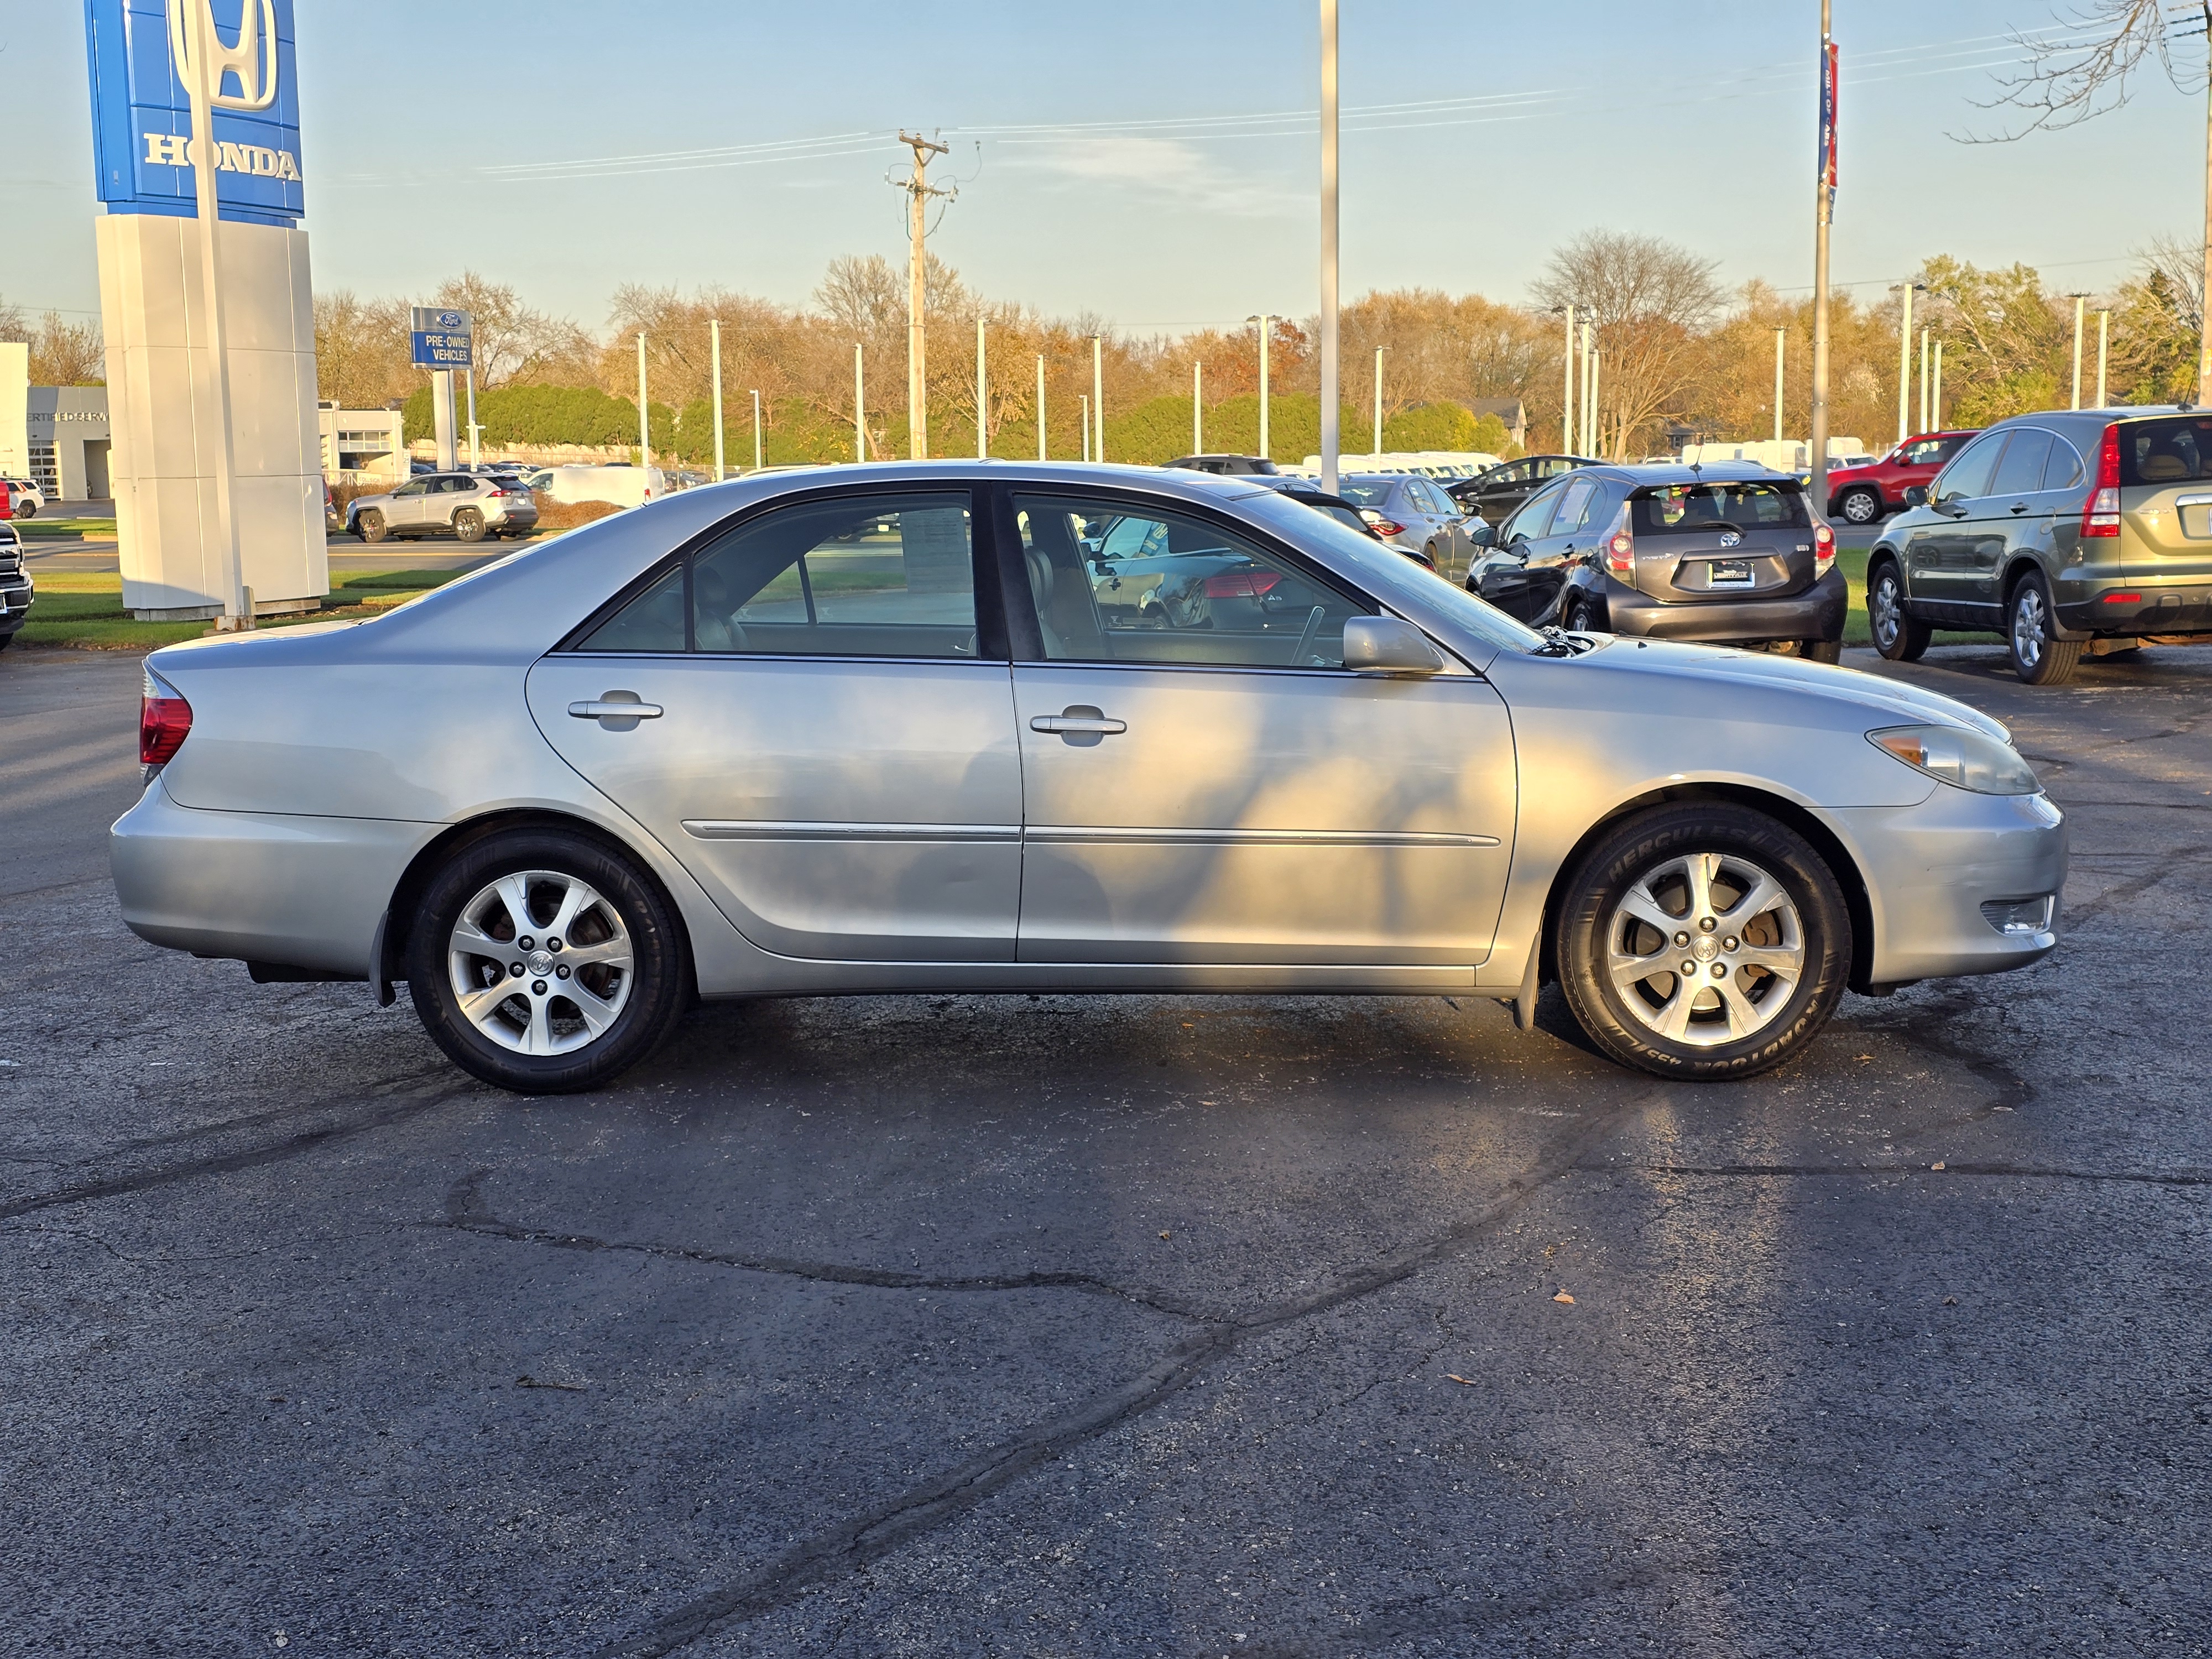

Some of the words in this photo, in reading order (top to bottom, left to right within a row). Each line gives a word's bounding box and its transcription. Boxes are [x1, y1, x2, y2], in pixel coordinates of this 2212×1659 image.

[1825, 99, 1832, 114] OF
[445, 314, 458, 326] Ford
[426, 335, 469, 348] PRE-OWNED
[433, 349, 467, 361] VEHICLES
[27, 412, 74, 421] ERTIFIED
[1608, 826, 1747, 883] HERCULES
[1647, 1049, 1682, 1065] 455
